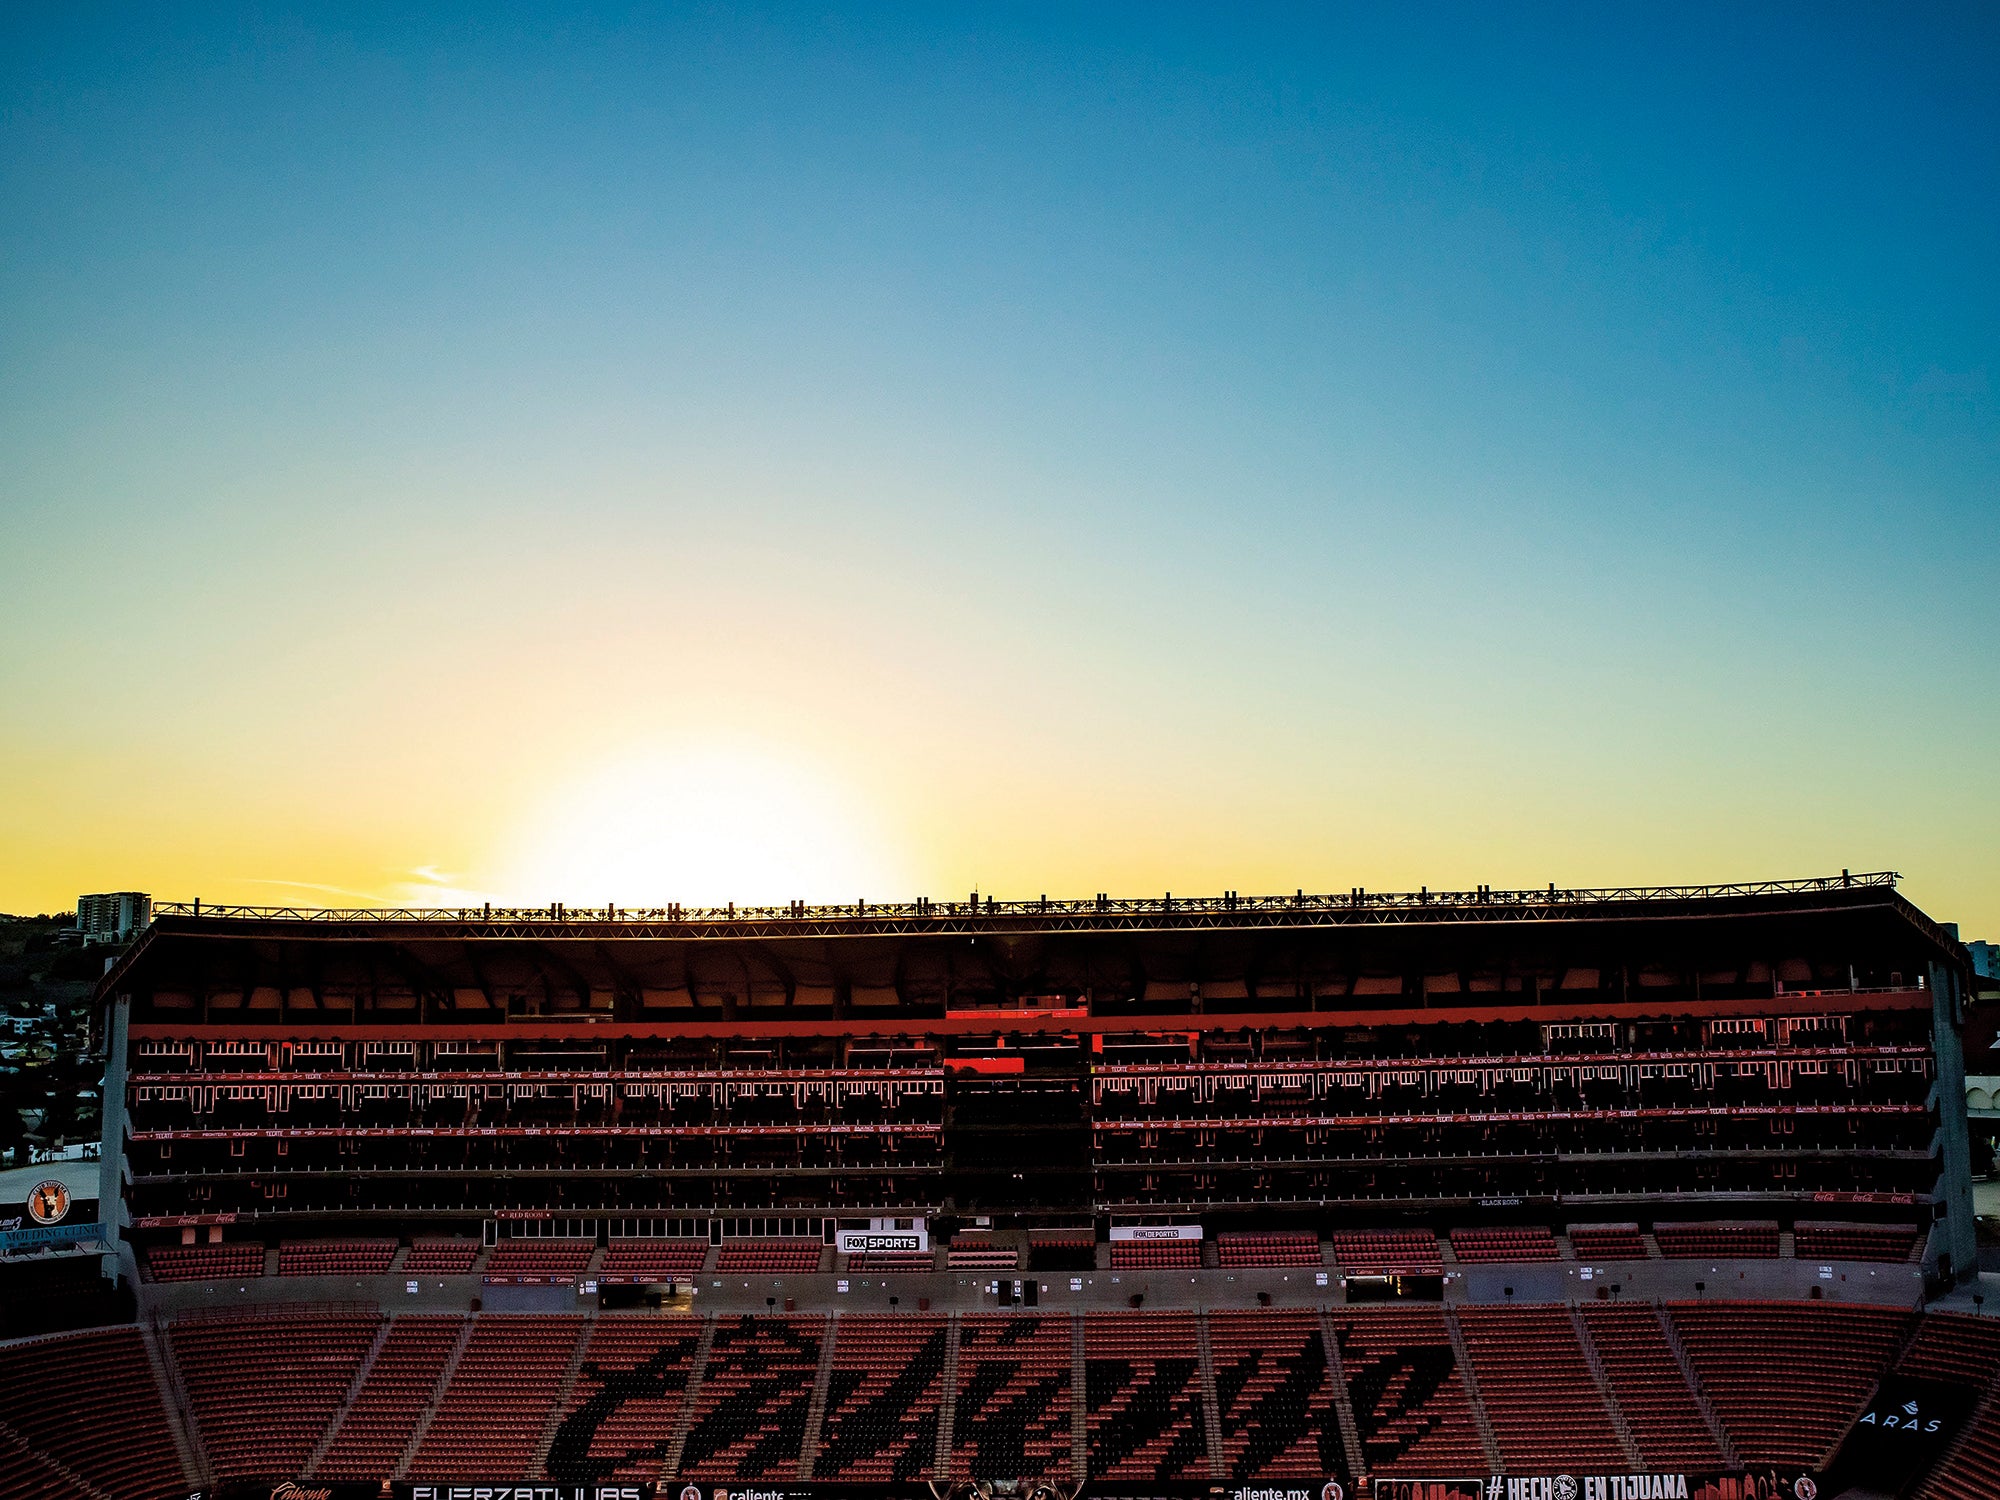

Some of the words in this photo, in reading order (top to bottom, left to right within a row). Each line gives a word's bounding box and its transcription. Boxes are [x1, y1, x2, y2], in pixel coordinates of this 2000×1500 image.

[1135, 1231, 1148, 1239] FOX
[1147, 1230, 1178, 1239] DEPORTES
[846, 1238, 866, 1248] FOX
[868, 1238, 917, 1248] SPORTS
[1859, 1412, 1942, 1432] ARAS
[1584, 1476, 1608, 1500] EN
[1610, 1475, 1688, 1500] TIJUANA
